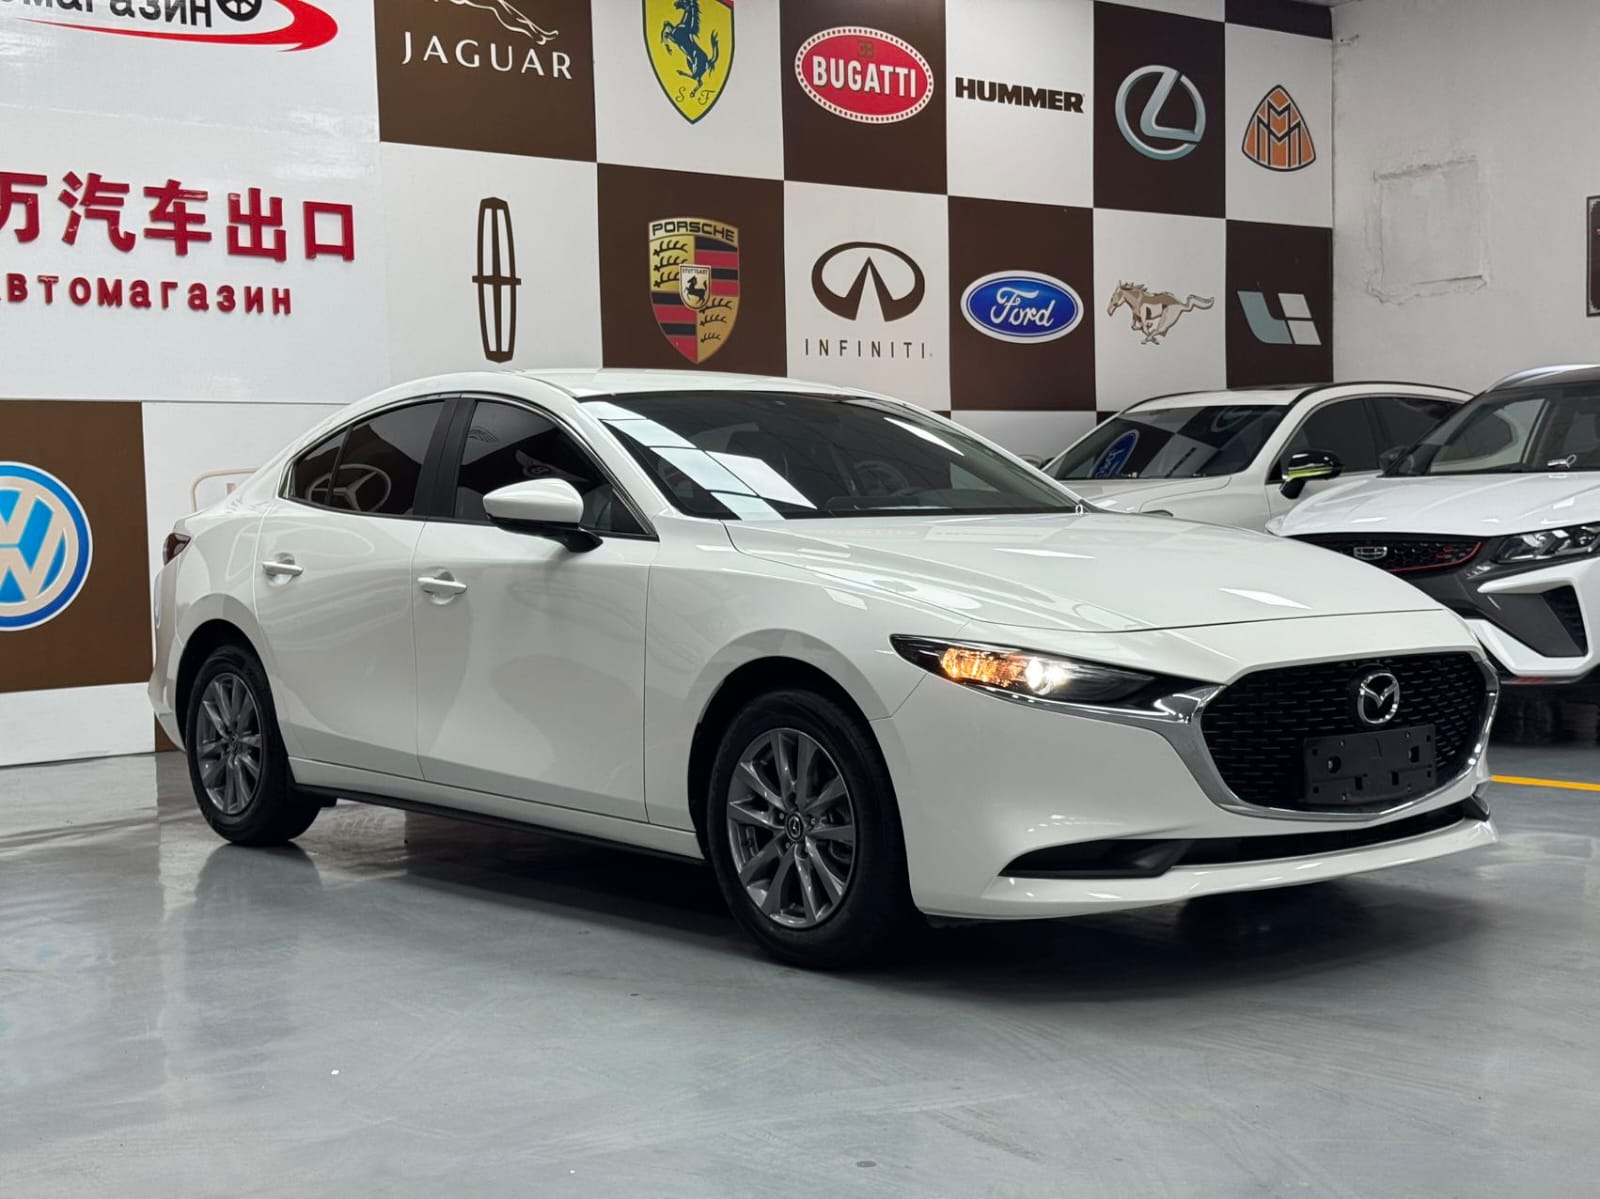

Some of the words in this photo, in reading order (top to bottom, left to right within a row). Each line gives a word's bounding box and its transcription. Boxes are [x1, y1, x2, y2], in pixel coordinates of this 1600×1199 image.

[402, 31, 573, 80] JAGUAR
[812, 55, 917, 98] BUGATTI
[955, 76, 1084, 114] HUMMER
[0, 171, 354, 263] 万汽车出口
[652, 221, 735, 242] PORSCHE
[0, 272, 292, 315] втомагазин
[990, 286, 1056, 328] Ford
[804, 338, 926, 359] INFINITI
